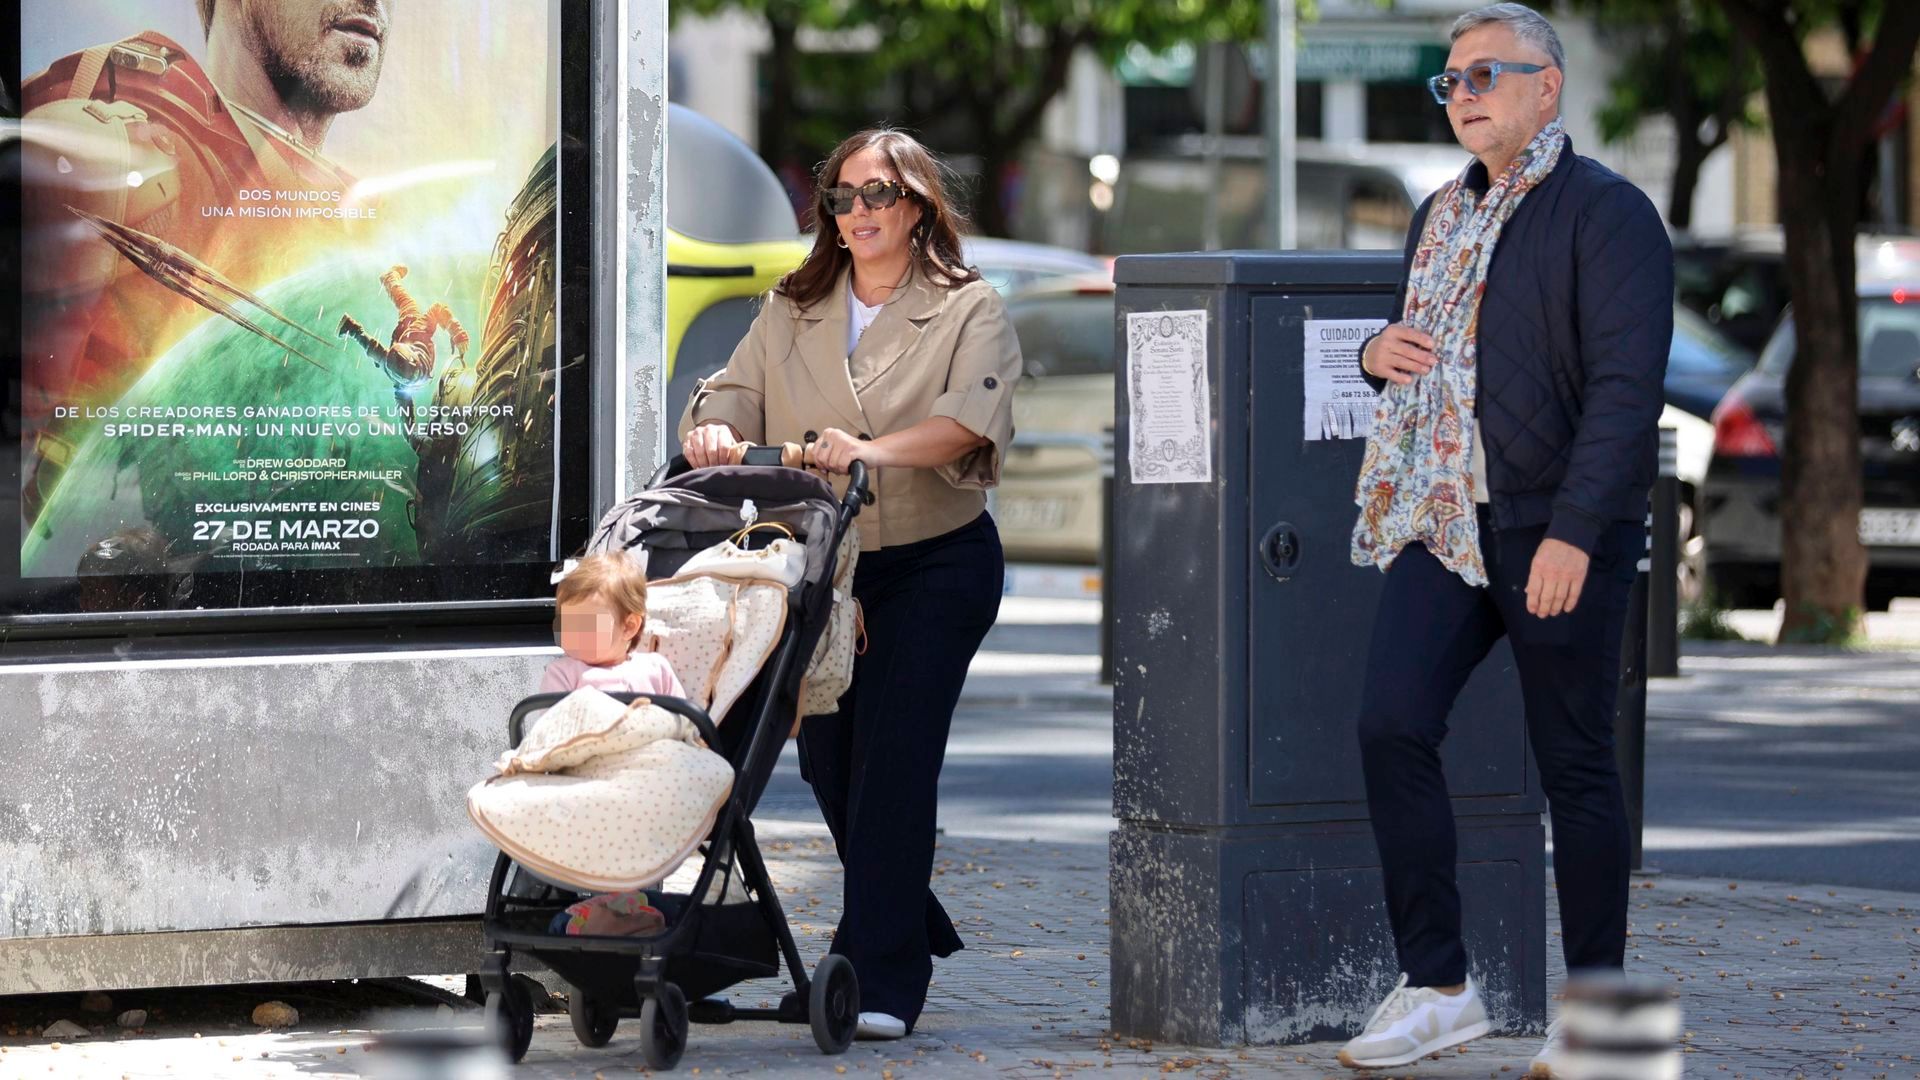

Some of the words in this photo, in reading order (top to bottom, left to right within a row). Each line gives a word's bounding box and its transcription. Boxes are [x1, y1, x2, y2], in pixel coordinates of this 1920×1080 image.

[239, 189, 272, 201] DOS
[275, 190, 341, 202] MUNDOS
[201, 206, 235, 217] UNA
[239, 204, 292, 218] MISIÓN
[296, 207, 377, 219] IMPOSIBLE
[1320, 328, 1360, 340] CUIDADO
[55, 406, 79, 418] DE
[86, 406, 120, 418] LOS
[126, 406, 237, 418] CREADORES
[243, 406, 352, 418] GANADORES
[357, 406, 380, 417] DE
[386, 406, 411, 417] UN
[479, 405, 514, 417] POR
[103, 423, 248, 437] SPIDER-MAN:
[256, 423, 284, 437] UN
[291, 423, 361, 436] NUEVO
[368, 422, 469, 436] UNIVERSO
[247, 458, 283, 468] DREW
[284, 458, 346, 468] GODDARD
[193, 471, 221, 481] PHIL
[223, 471, 257, 481] LORD
[259, 470, 269, 481] &
[270, 470, 357, 481] CHRISTOPHER
[358, 470, 403, 480] MILLER
[195, 502, 317, 513] EXCLUSIVAMENTE
[320, 502, 338, 512] EN
[340, 502, 381, 512] CINES
[193, 520, 226, 541] 27
[232, 520, 272, 540] DE
[279, 519, 380, 540] MARZO
[232, 542, 279, 551] RODADA
[281, 542, 310, 551] PARA
[311, 541, 341, 551] IMAX
